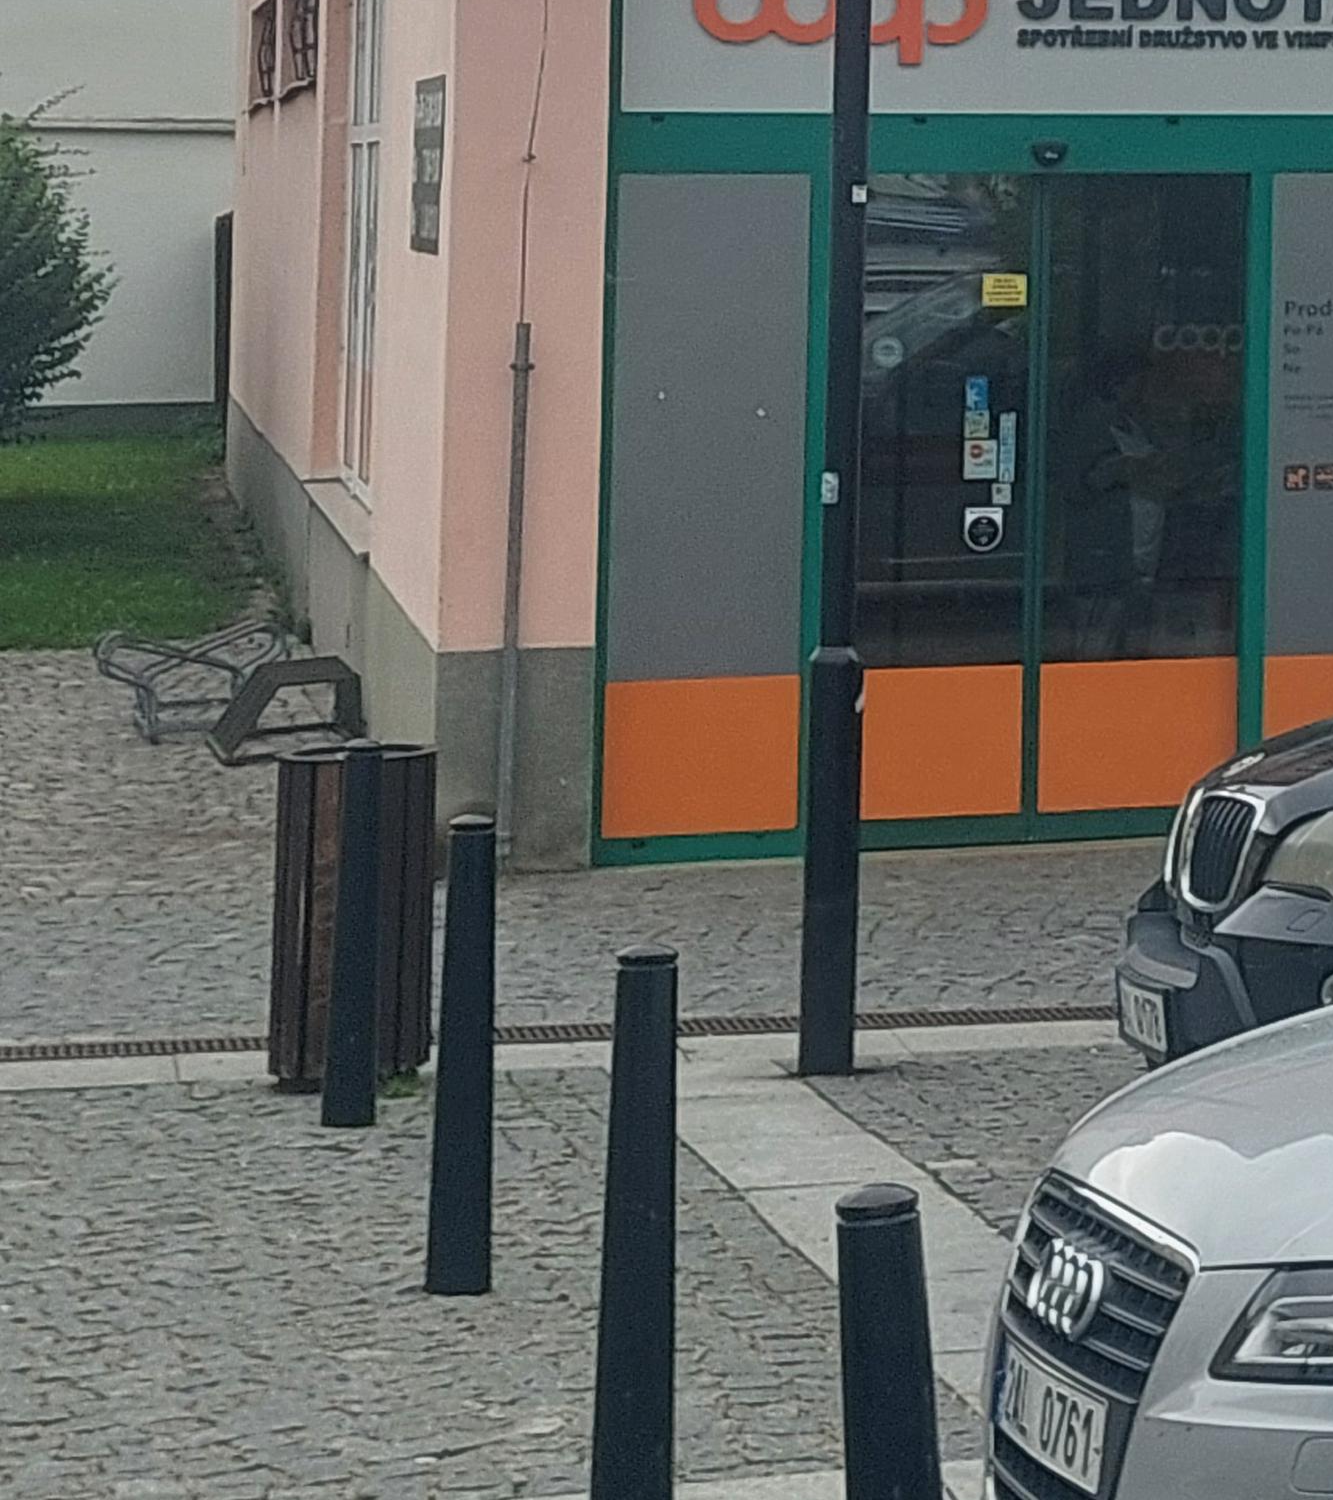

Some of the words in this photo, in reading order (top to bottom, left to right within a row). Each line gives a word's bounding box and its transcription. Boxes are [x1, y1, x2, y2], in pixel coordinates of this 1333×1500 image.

[1139, 26, 1247, 49] DRUŽSTVO
[1252, 30, 1278, 49] VE
[1040, 1385, 1095, 1478] 0761
